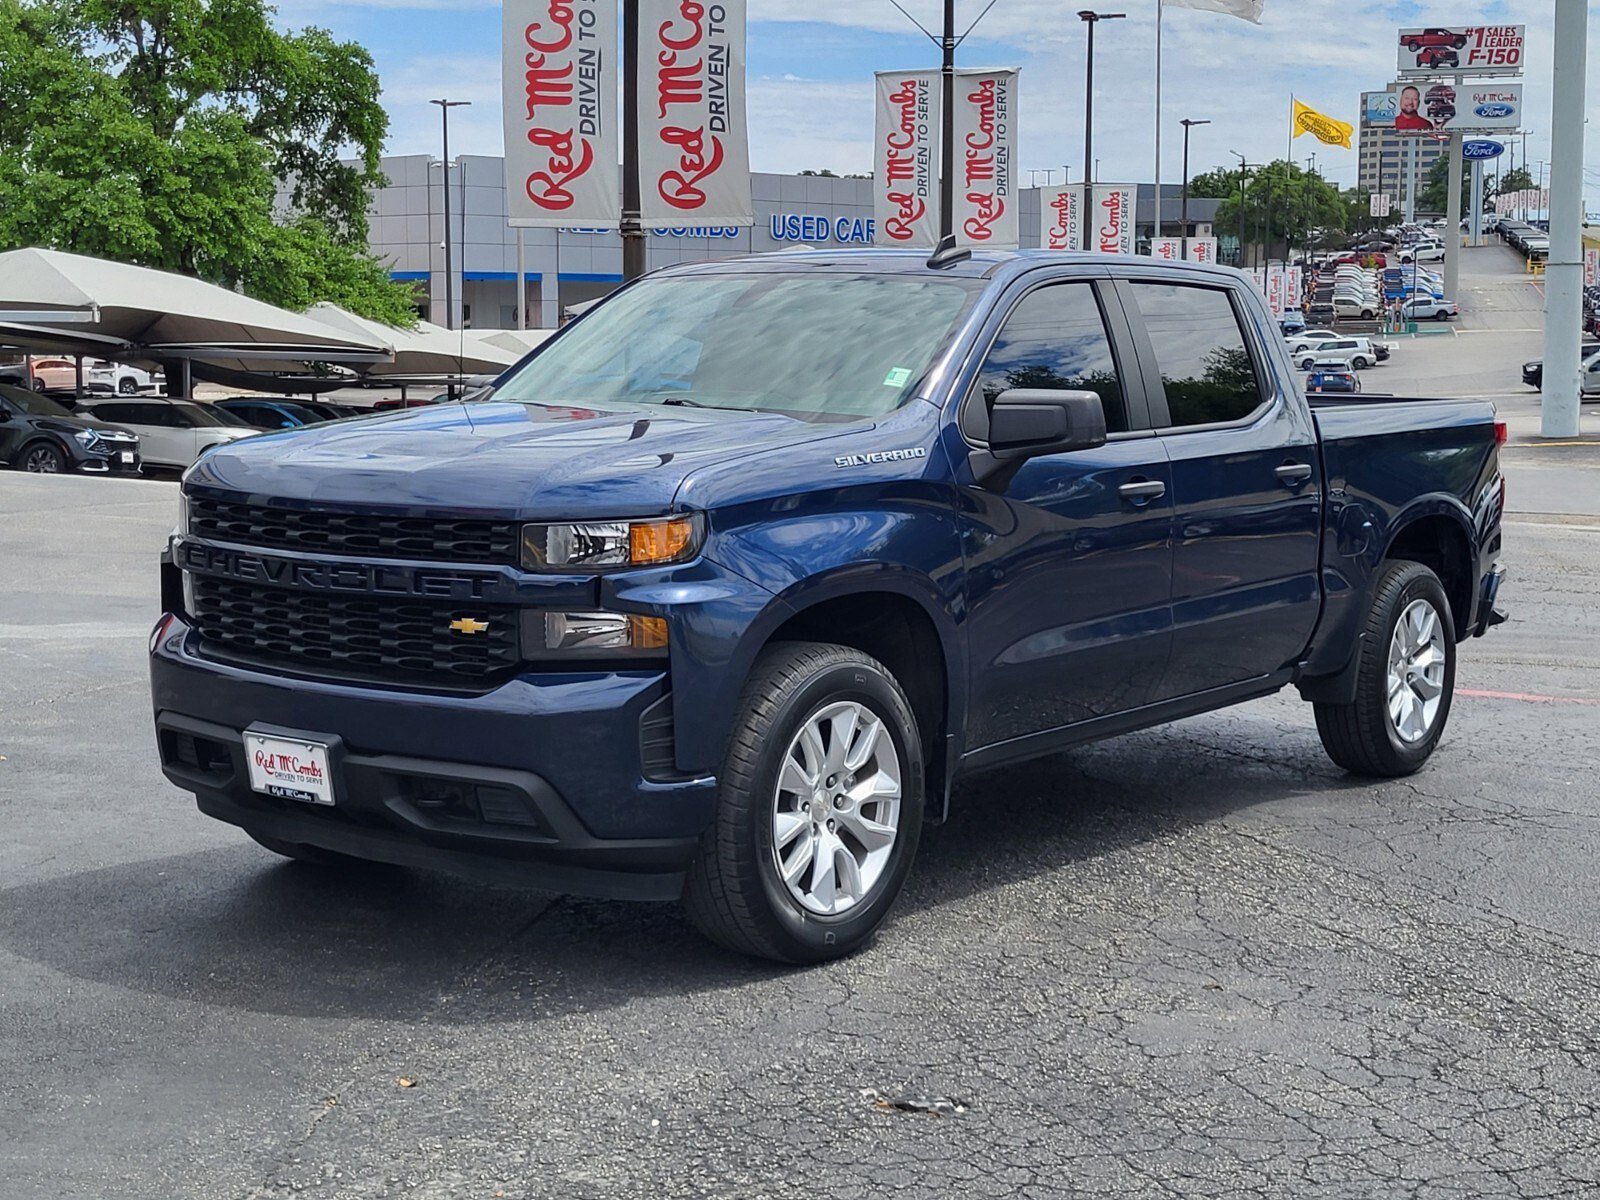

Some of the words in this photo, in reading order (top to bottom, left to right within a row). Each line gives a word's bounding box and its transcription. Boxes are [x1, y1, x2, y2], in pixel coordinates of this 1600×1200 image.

[578, 9, 596, 41] TO
[708, 5, 726, 37] TO
[1465, 27, 1485, 48] #1
[1486, 27, 1516, 37] SALES
[1484, 37, 1522, 47] LEADER
[525, 0, 574, 120] McCo
[658, 0, 705, 119] McCo
[1467, 48, 1520, 65] F-150
[578, 48, 596, 136] DRIVEN
[708, 44, 726, 133] DRIVEN
[918, 80, 929, 121] SERVE
[997, 79, 1006, 120] SERVE
[1481, 106, 1507, 116] Ford
[886, 80, 917, 188] McCombs
[918, 124, 928, 143] TO
[965, 80, 995, 188] McCombs
[997, 124, 1006, 143] TO
[1464, 143, 1495, 156] Ford
[526, 128, 593, 210] Red
[658, 126, 724, 210] Red
[917, 146, 928, 197] DRIVEN
[996, 146, 1006, 197] DRIVEN
[885, 192, 925, 241] Red
[963, 192, 1005, 241] Red
[1069, 192, 1077, 219] SERVE
[772, 214, 830, 240] USED
[1069, 222, 1077, 234] TO
[1121, 221, 1128, 233] TO
[834, 447, 926, 468] SILVERADO
[186, 543, 499, 600] CHEVROLET
[255, 749, 275, 775] Red
[276, 753, 322, 777] McCombs
[275, 771, 296, 780] DRIVEN
[296, 774, 305, 782] TO
[306, 776, 323, 785] SERVE
